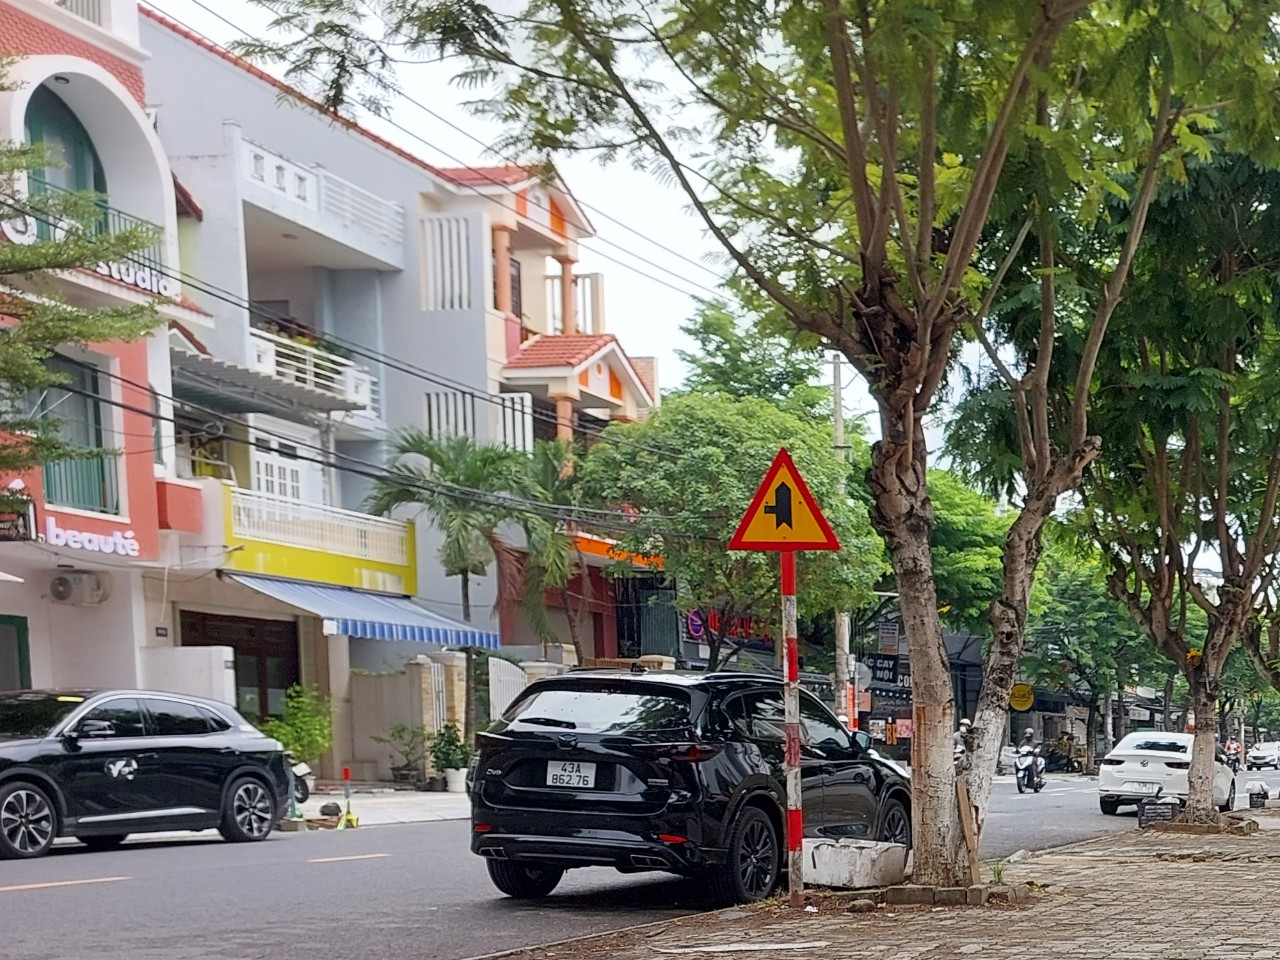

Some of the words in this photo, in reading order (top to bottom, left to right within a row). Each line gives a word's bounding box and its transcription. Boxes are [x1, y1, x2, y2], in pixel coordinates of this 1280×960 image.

[46, 516, 139, 557] beauté
[560, 763, 581, 774] 43A
[551, 774, 589, 786] 862.76
